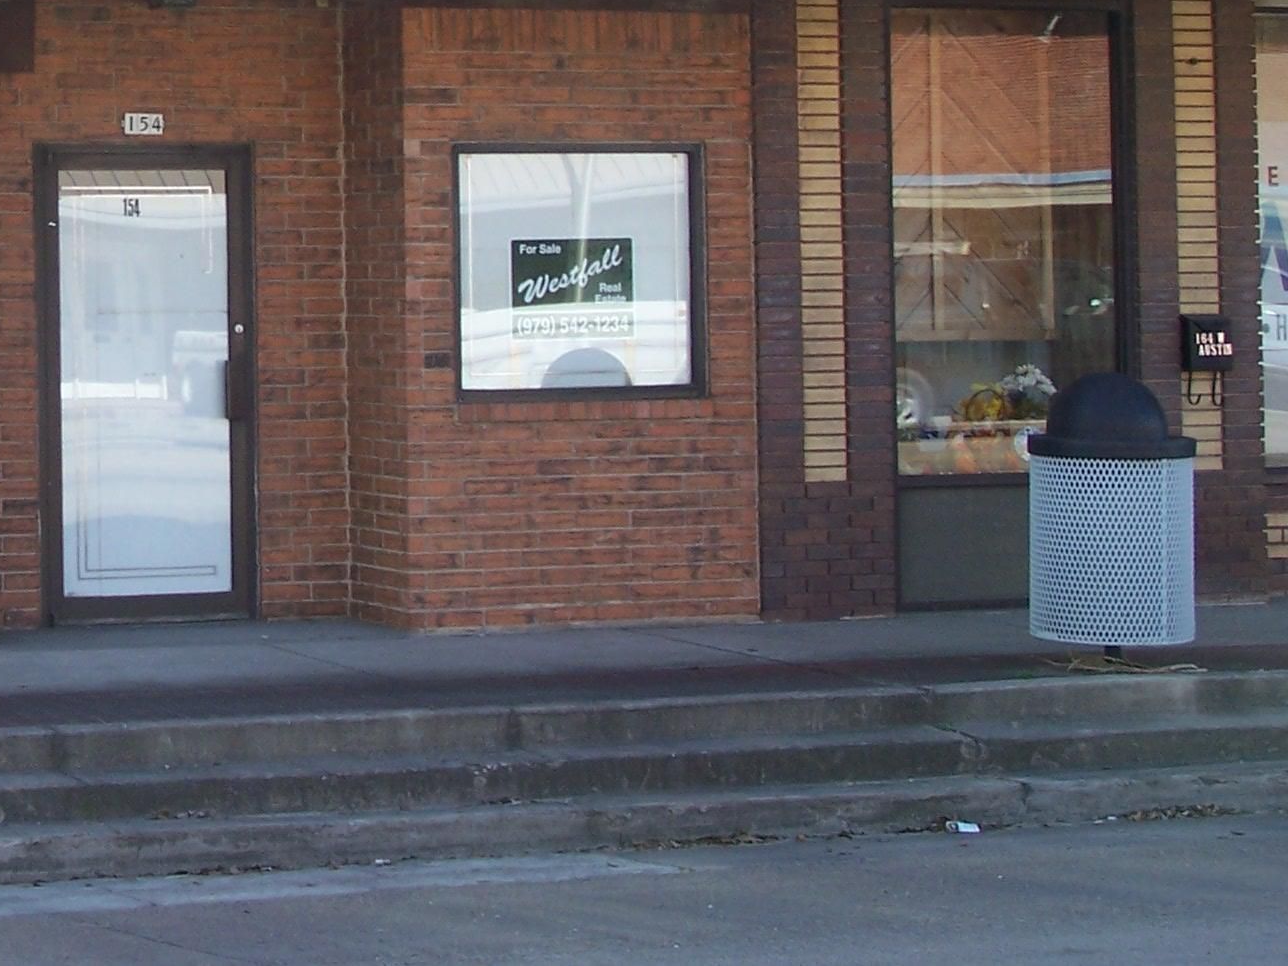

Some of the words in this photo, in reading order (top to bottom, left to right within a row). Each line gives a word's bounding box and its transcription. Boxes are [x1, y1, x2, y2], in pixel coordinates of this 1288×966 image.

[128, 116, 161, 132] 154
[122, 198, 141, 217] 154
[519, 244, 537, 254] For
[538, 244, 561, 254] Sale
[517, 244, 623, 304] Westfall
[599, 282, 622, 292] Real
[517, 316, 556, 335] (979)
[559, 315, 630, 334] 542-1234
